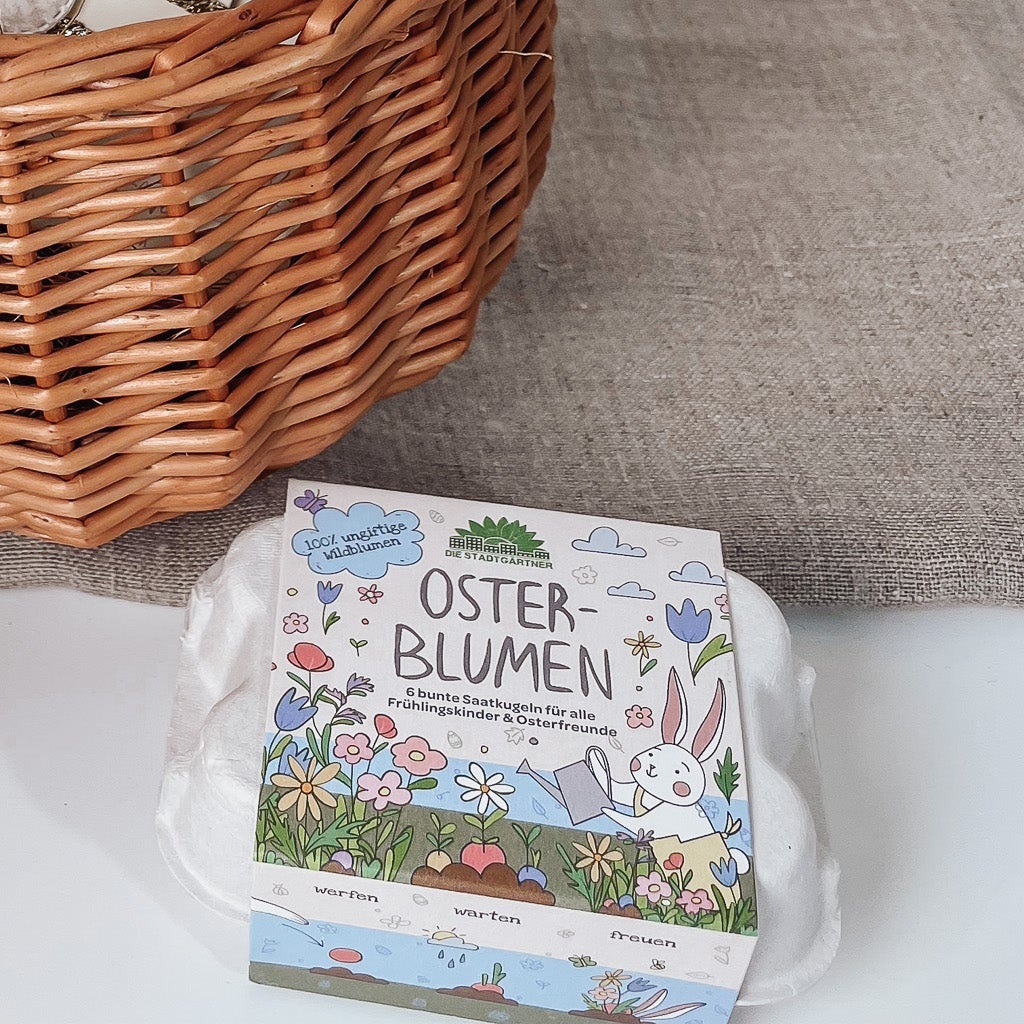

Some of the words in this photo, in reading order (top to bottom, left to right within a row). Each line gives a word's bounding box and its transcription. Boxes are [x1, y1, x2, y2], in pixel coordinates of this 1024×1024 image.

[304, 533, 338, 551] 100%
[340, 522, 407, 542] ungiftige
[322, 538, 402, 560] Wildblumen
[445, 549, 462, 559] DIE
[419, 567, 599, 633] OSTER-
[393, 623, 613, 701] BLUMEN
[406, 687, 415, 697] 6
[417, 688, 460, 703] bunte
[462, 694, 543, 715] Saatkugeln
[545, 705, 567, 717] für
[569, 709, 596, 721] alle
[388, 697, 501, 722] Frühlingskinder
[503, 713, 513, 723] &
[516, 714, 618, 737] Osterfreunde
[313, 885, 379, 903] werfen
[453, 906, 522, 925] warten
[609, 930, 677, 948] freuen
